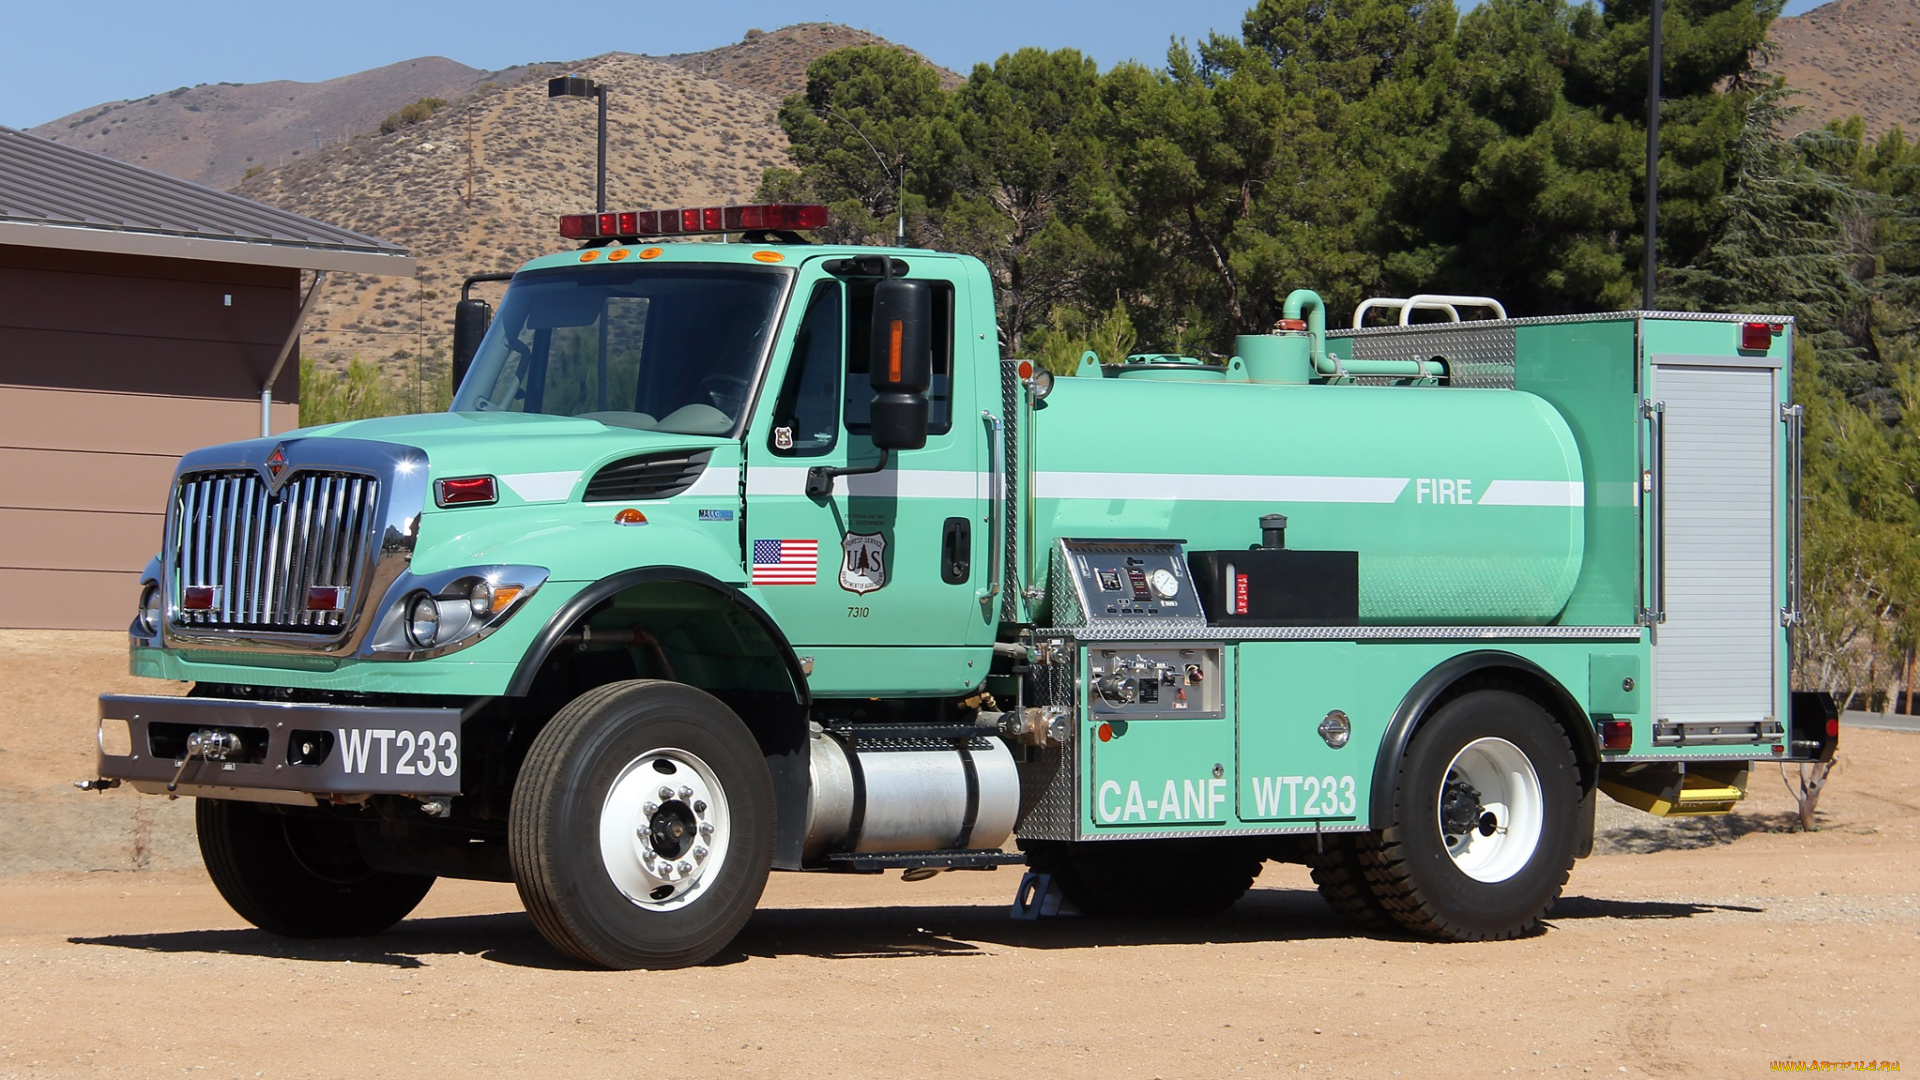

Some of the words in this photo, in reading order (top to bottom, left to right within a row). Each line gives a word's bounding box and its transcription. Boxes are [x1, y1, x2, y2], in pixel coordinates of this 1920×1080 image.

[1416, 478, 1473, 505] FIRE
[846, 537, 863, 548] FOREST
[863, 537, 883, 549] SERVICE
[847, 606, 870, 618] 7310
[338, 728, 458, 776] WT233
[1099, 779, 1227, 822] CA-ANF
[1252, 775, 1356, 817] WT233
